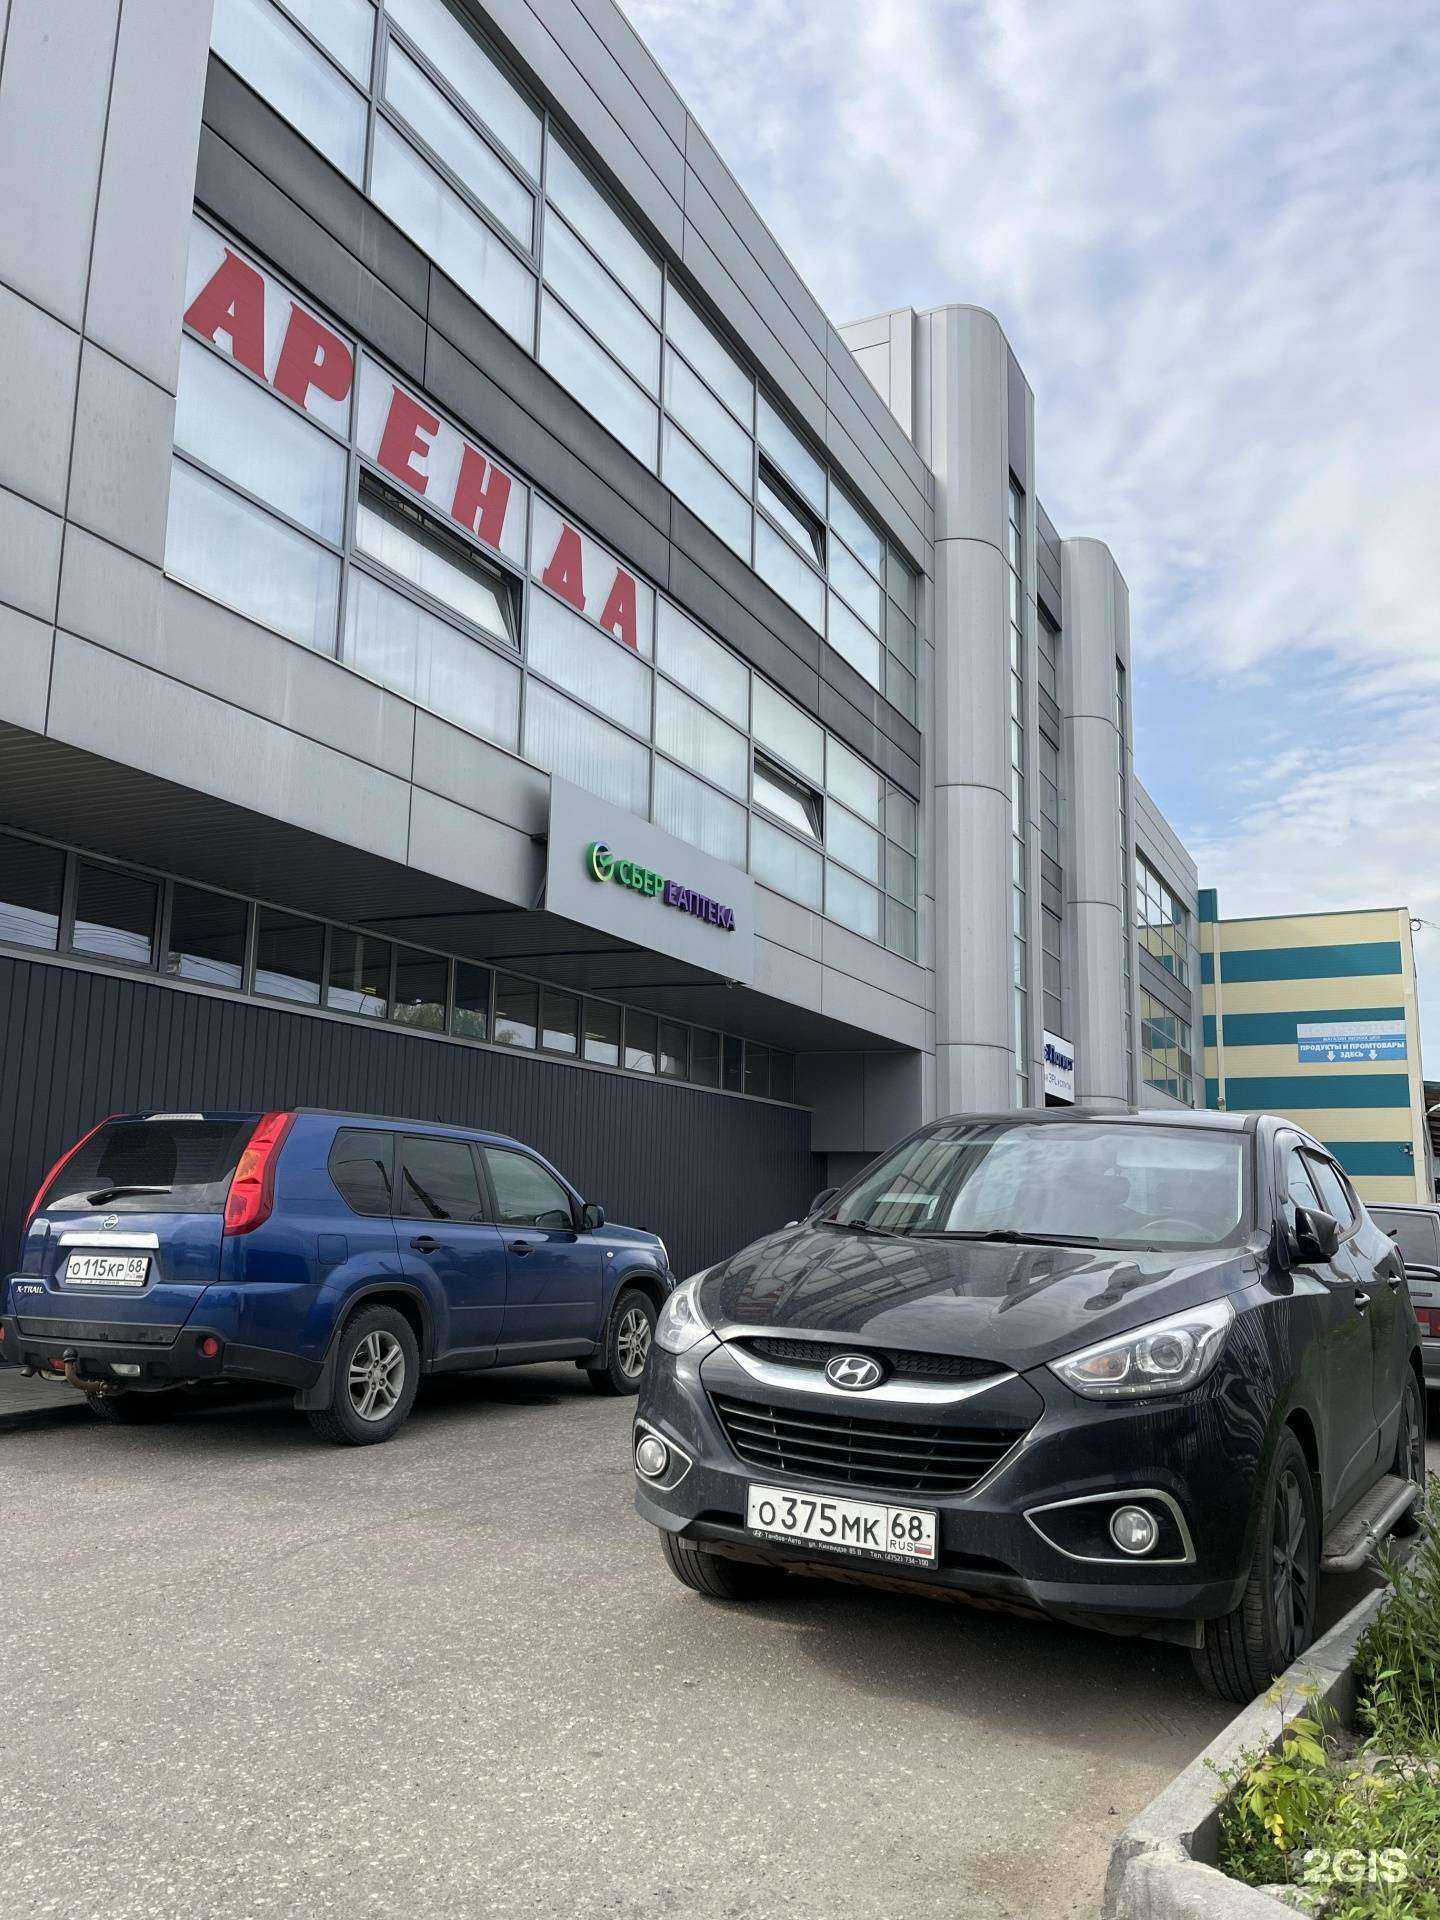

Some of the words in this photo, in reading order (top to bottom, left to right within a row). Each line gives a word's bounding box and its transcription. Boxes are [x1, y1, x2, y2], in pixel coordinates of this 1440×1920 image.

[183, 247, 639, 652] АРЕНДА
[613, 859, 664, 897] СБЕР
[663, 879, 736, 931] ЕАПТЕКА
[1300, 1043, 1342, 1051] ПРОДУКТЫ
[1349, 1041, 1405, 1050] ПРОМТОВАРЫ
[128, 1259, 142, 1273] 68
[16, 1285, 44, 1294] X-TRAIL
[891, 1512, 923, 1542] 68
[889, 1539, 914, 1552] RUS
